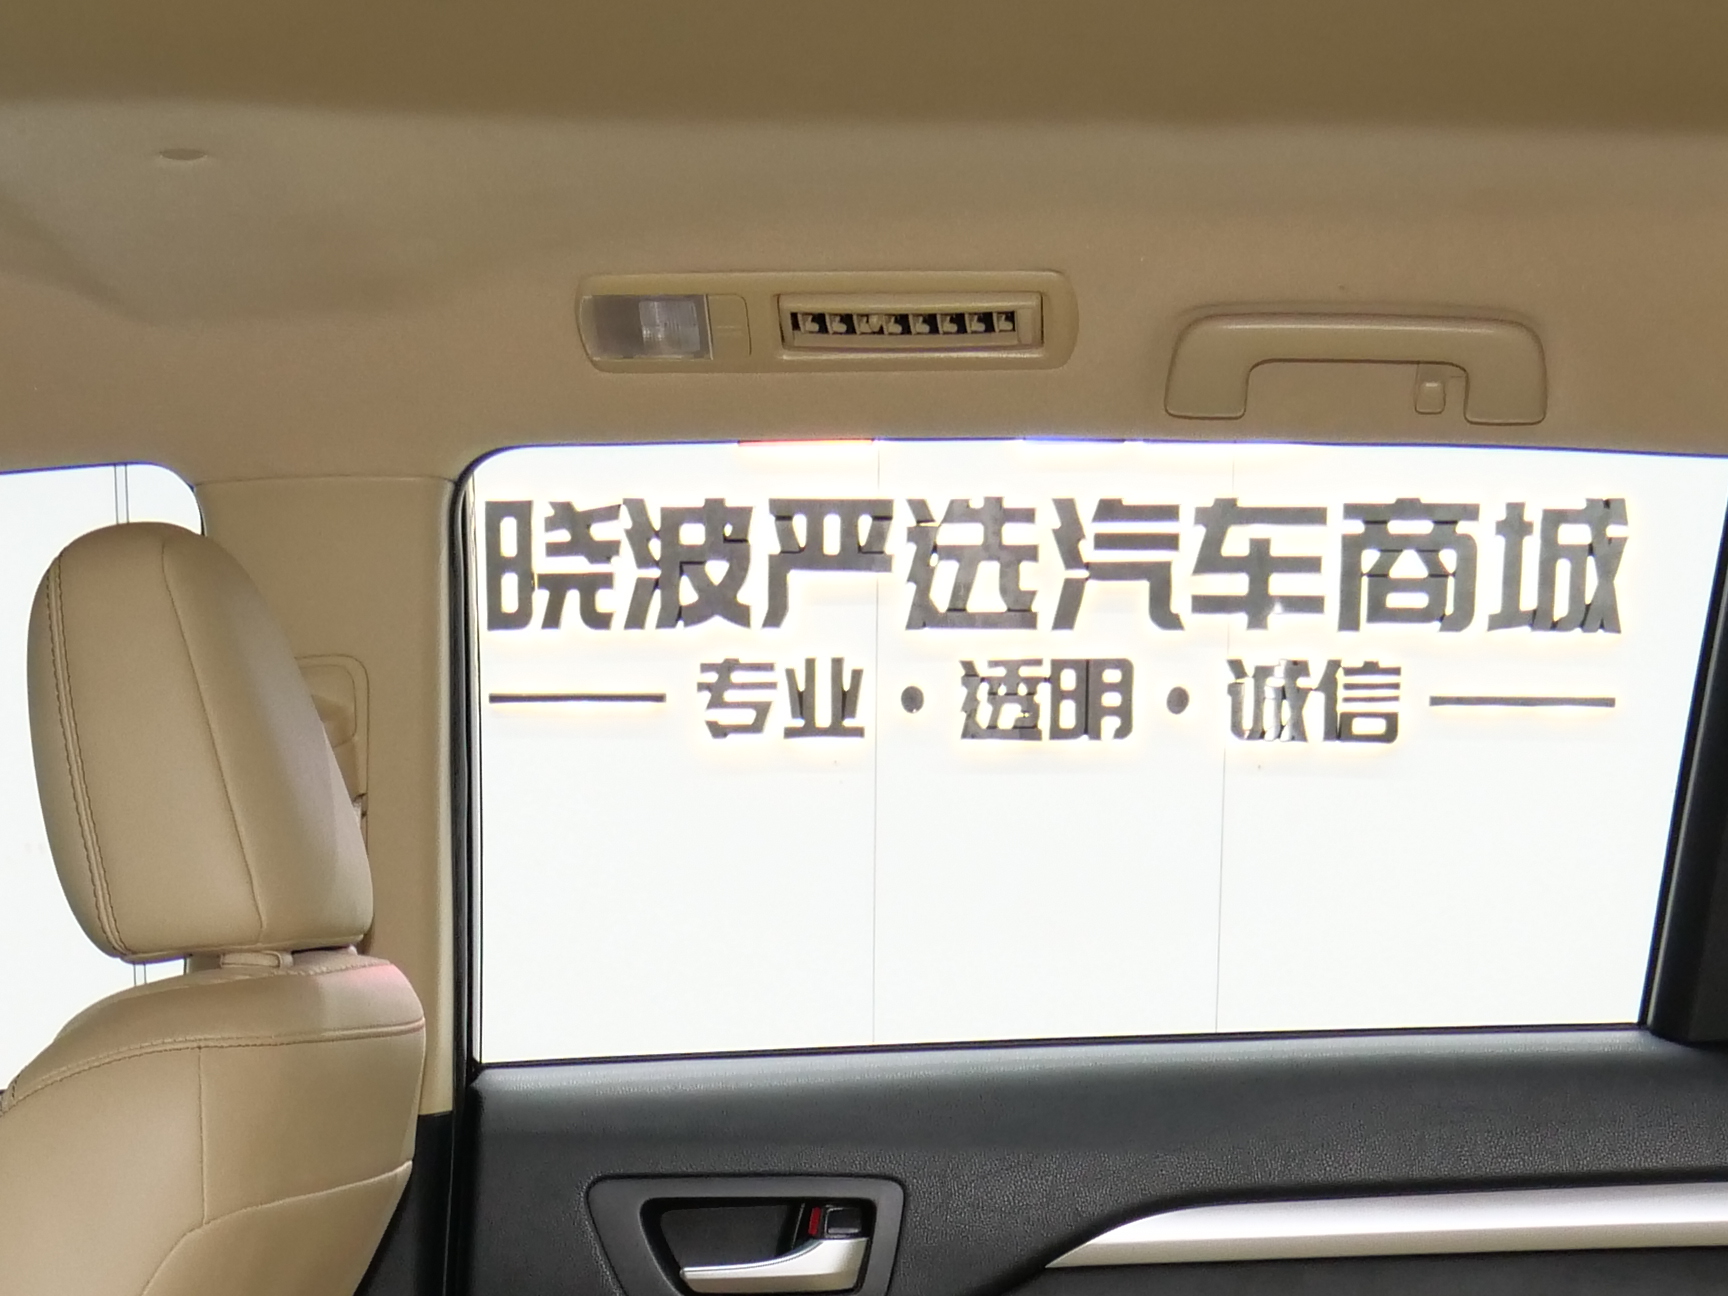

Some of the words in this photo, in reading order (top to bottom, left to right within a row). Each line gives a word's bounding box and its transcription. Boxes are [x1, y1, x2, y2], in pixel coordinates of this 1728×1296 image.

[484, 497, 1629, 633] 晓波严选汽车商城
